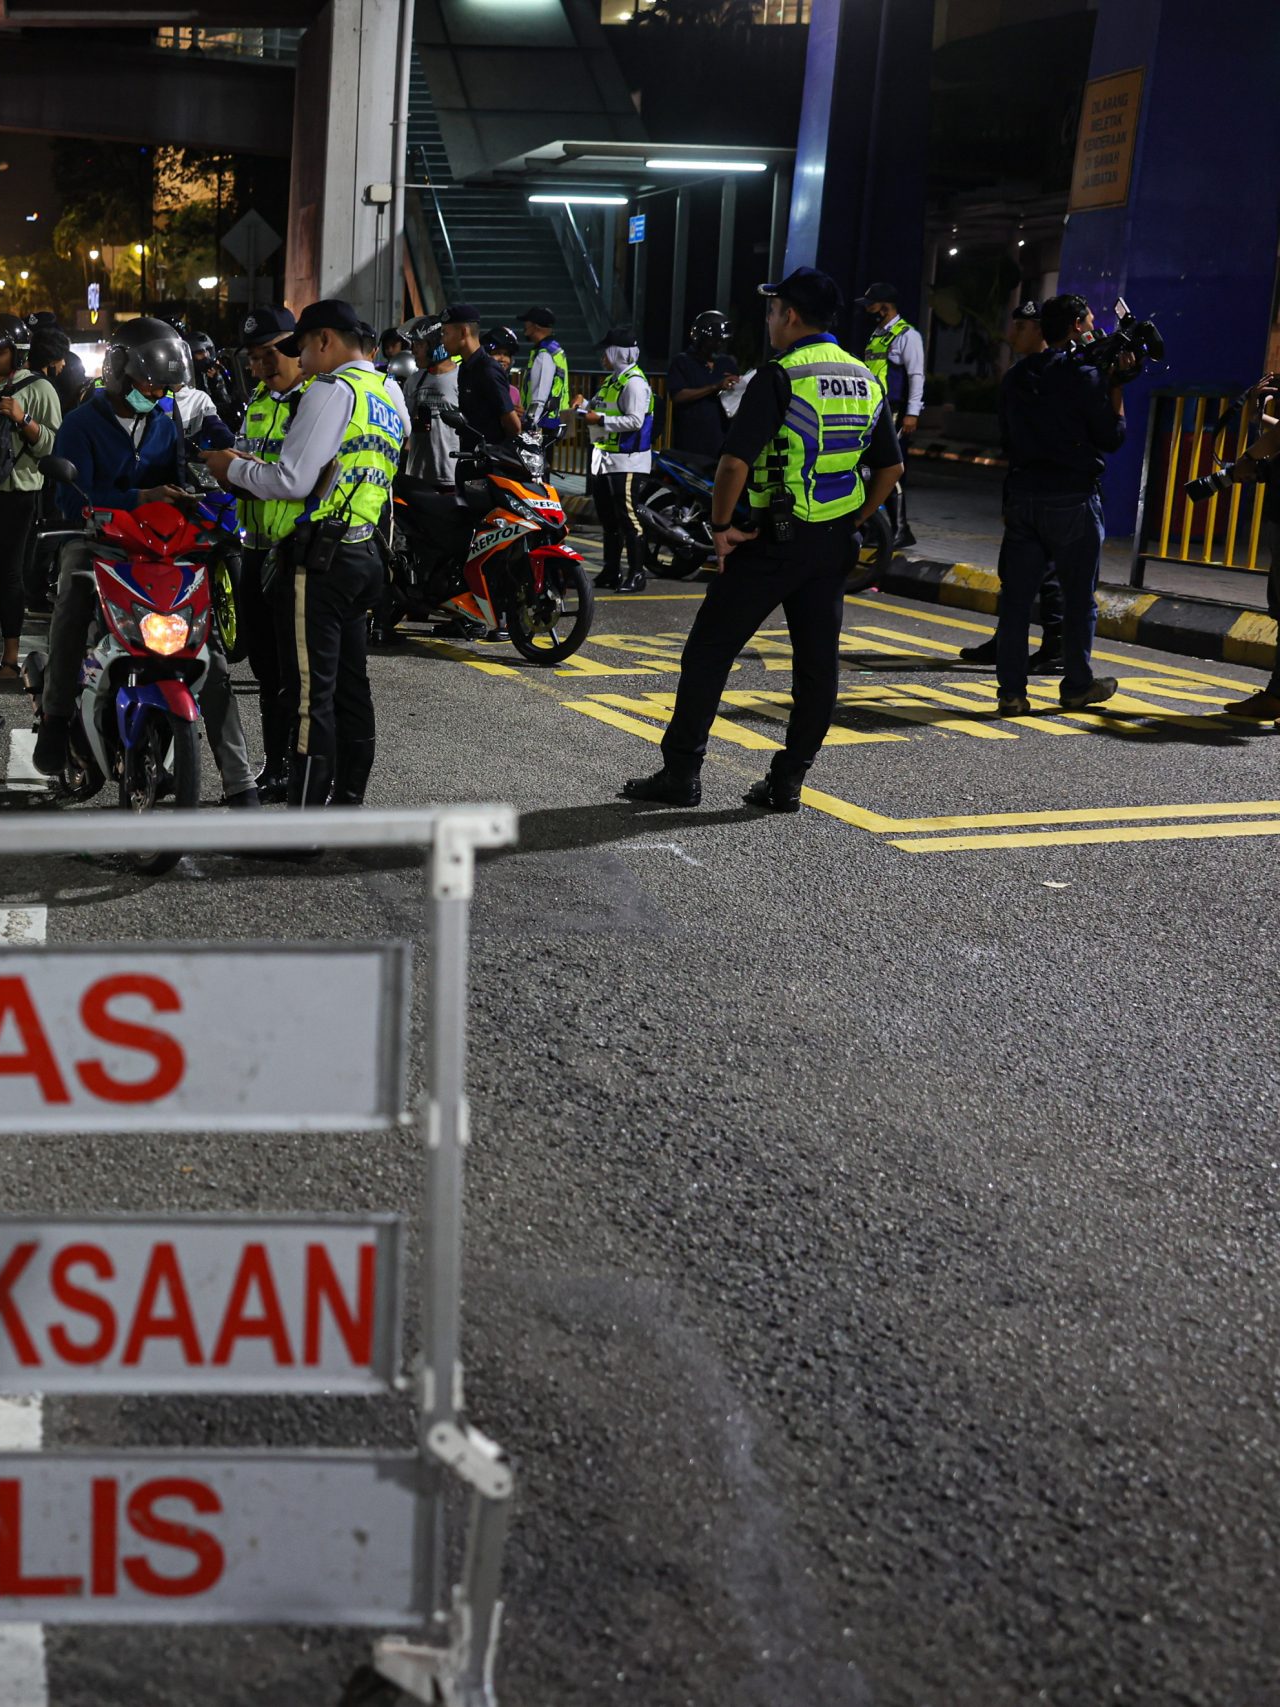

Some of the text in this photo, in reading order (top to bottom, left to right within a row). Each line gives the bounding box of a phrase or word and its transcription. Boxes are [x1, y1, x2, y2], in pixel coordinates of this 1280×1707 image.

[820, 379, 868, 397] POLIS
[371, 398, 401, 440] POLIS
[471, 525, 521, 555] REPSOL
